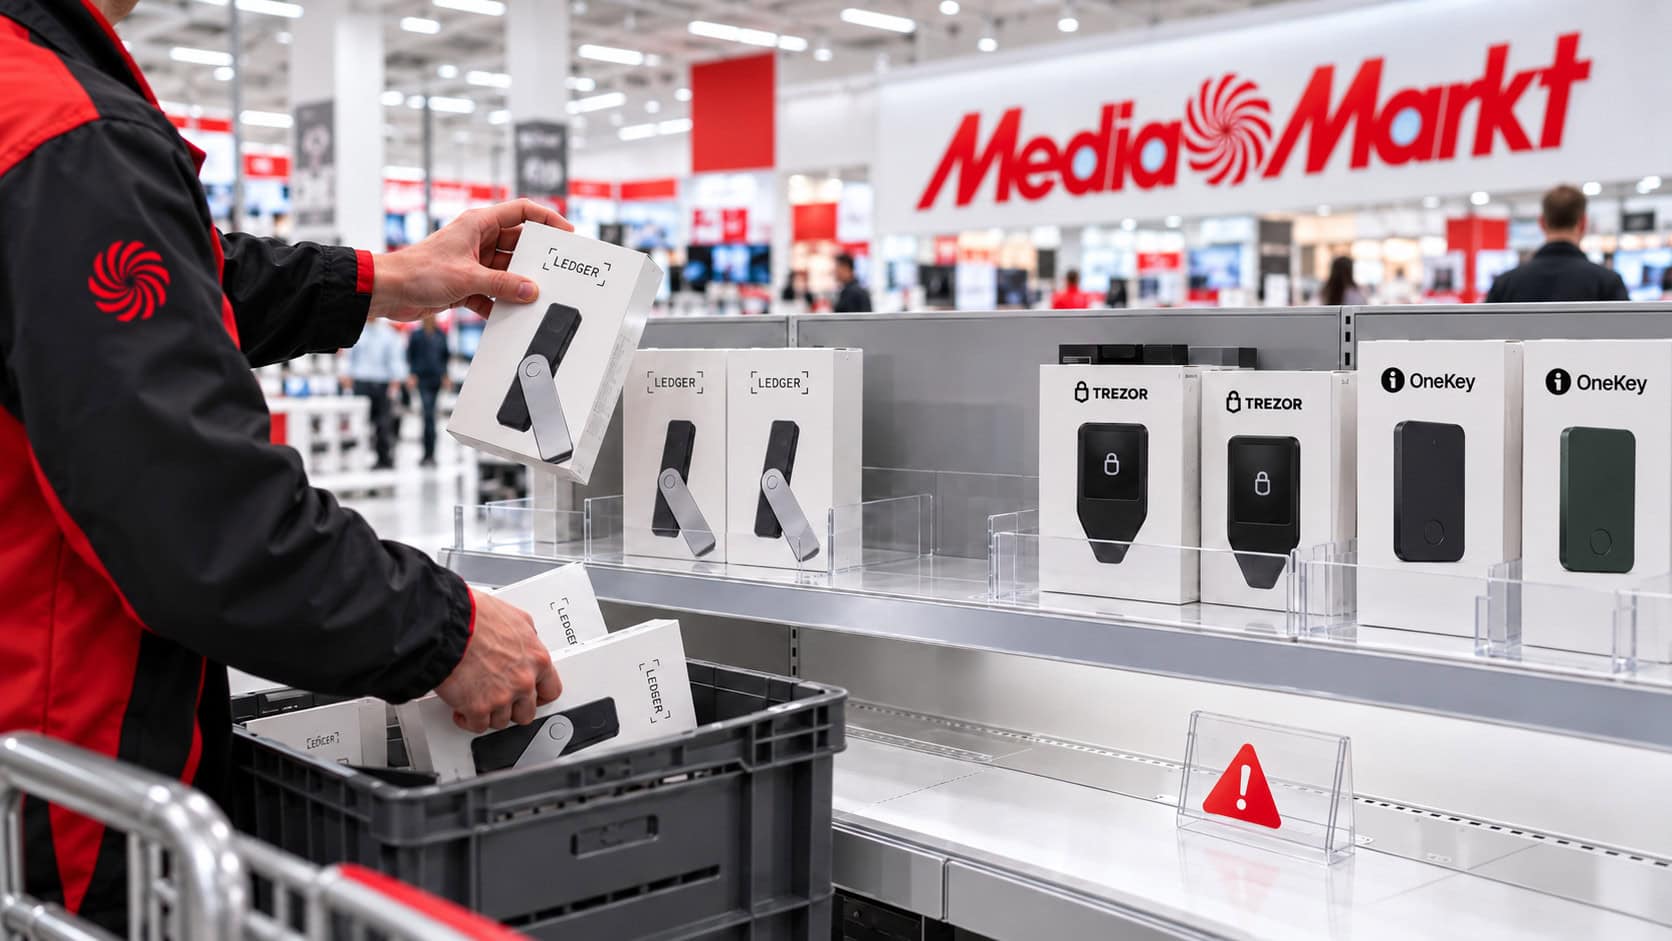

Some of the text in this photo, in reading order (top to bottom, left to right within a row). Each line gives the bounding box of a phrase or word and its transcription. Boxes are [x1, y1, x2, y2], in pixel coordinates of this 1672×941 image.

[916, 31, 1592, 211] Media Markt
[553, 256, 600, 278] LEDGER
[654, 377, 696, 388] LEDGER
[758, 377, 801, 388] LEDGER
[1409, 372, 1476, 392] OneKey
[1576, 374, 1648, 395] OneKey
[1093, 387, 1148, 400] TREZOR
[1245, 397, 1303, 411] TREZOR
[646, 669, 663, 714] LEDGER
